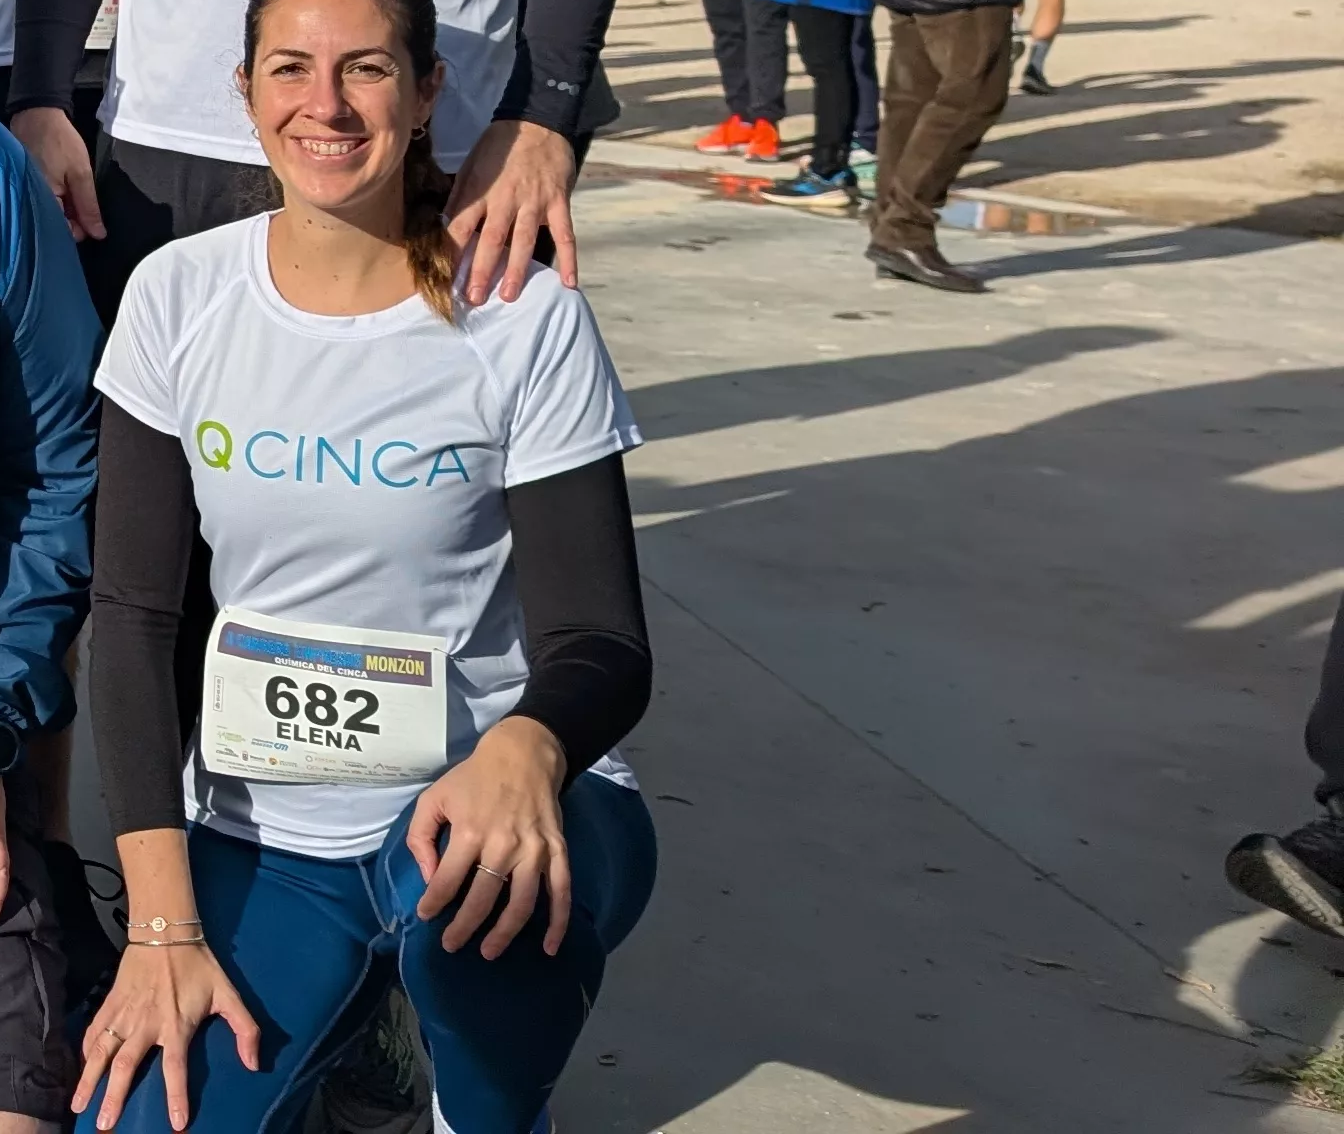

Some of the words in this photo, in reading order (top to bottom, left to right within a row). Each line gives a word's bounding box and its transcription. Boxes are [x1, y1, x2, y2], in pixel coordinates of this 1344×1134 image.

[274, 656, 315, 671] QUÍMICA
[317, 663, 335, 673] DEL
[337, 667, 368, 678] CINCA
[365, 654, 425, 676] MONZÓN
[265, 675, 380, 735] 682
[276, 721, 363, 753] ELENA
